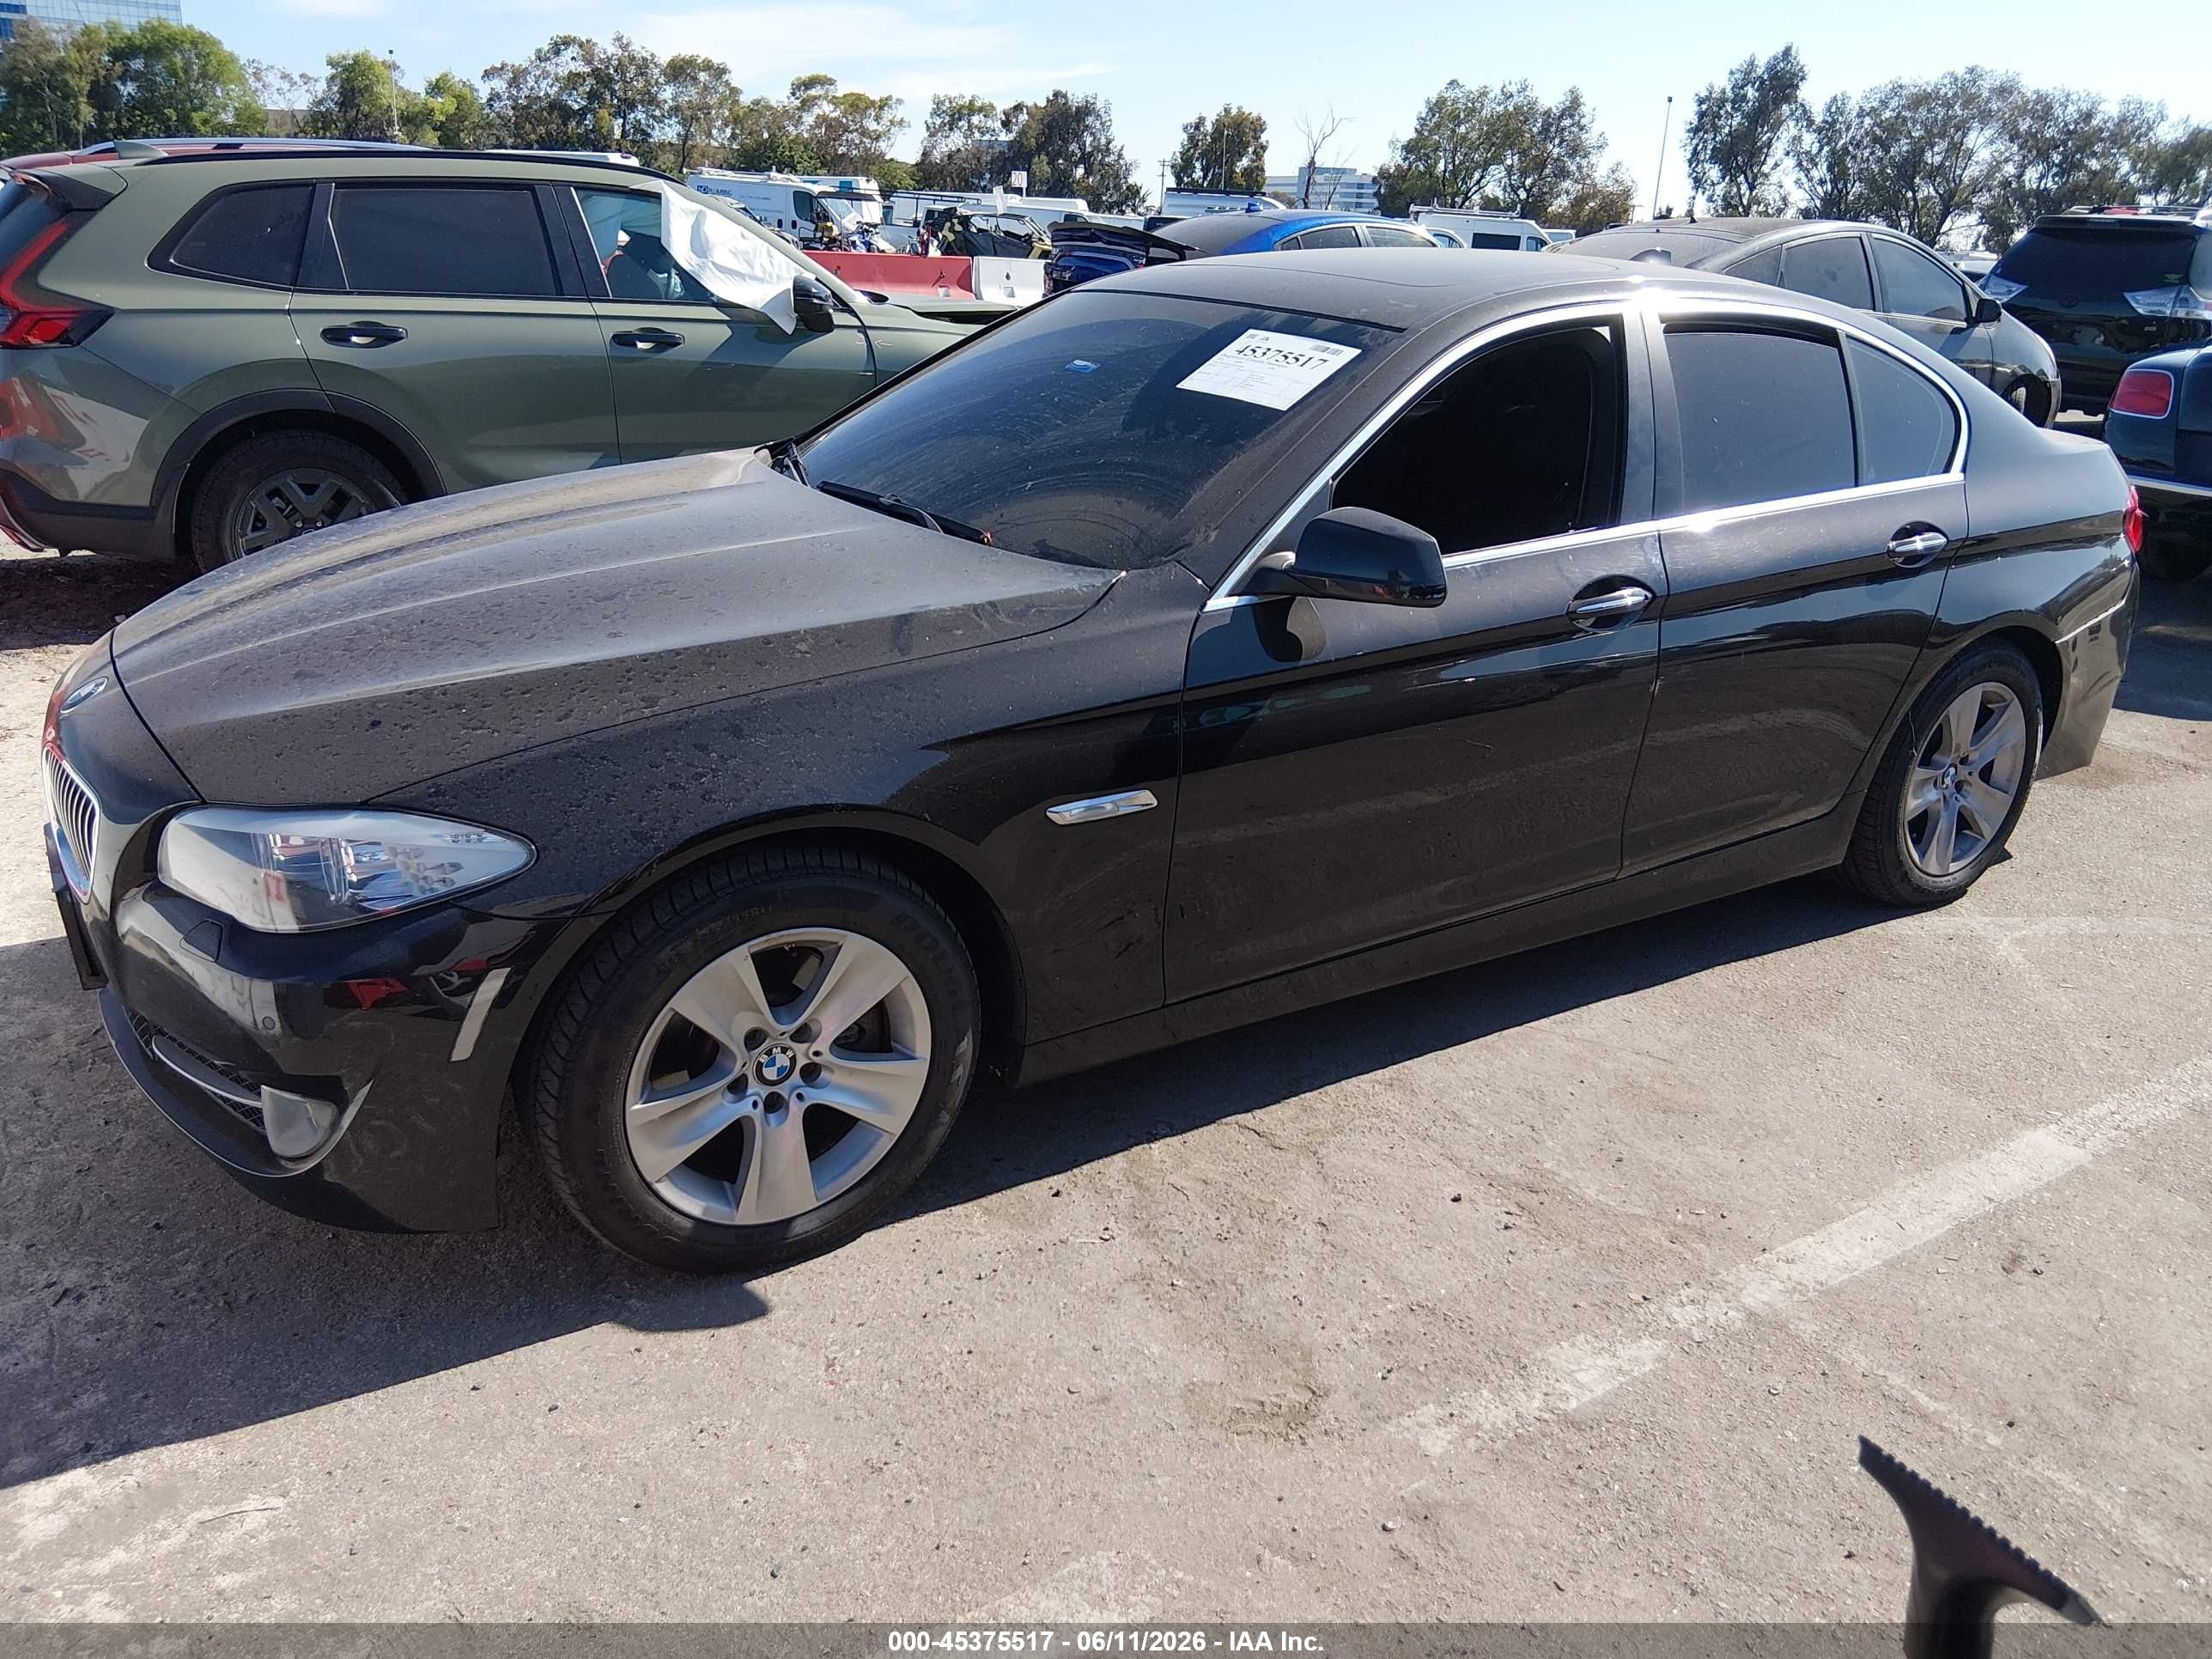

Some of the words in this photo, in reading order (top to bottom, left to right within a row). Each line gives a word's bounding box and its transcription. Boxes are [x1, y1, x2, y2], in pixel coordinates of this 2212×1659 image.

[1012, 173, 1023, 185] 20
[1235, 344, 1329, 369] 45375517
[759, 1047, 794, 1062] BMW
